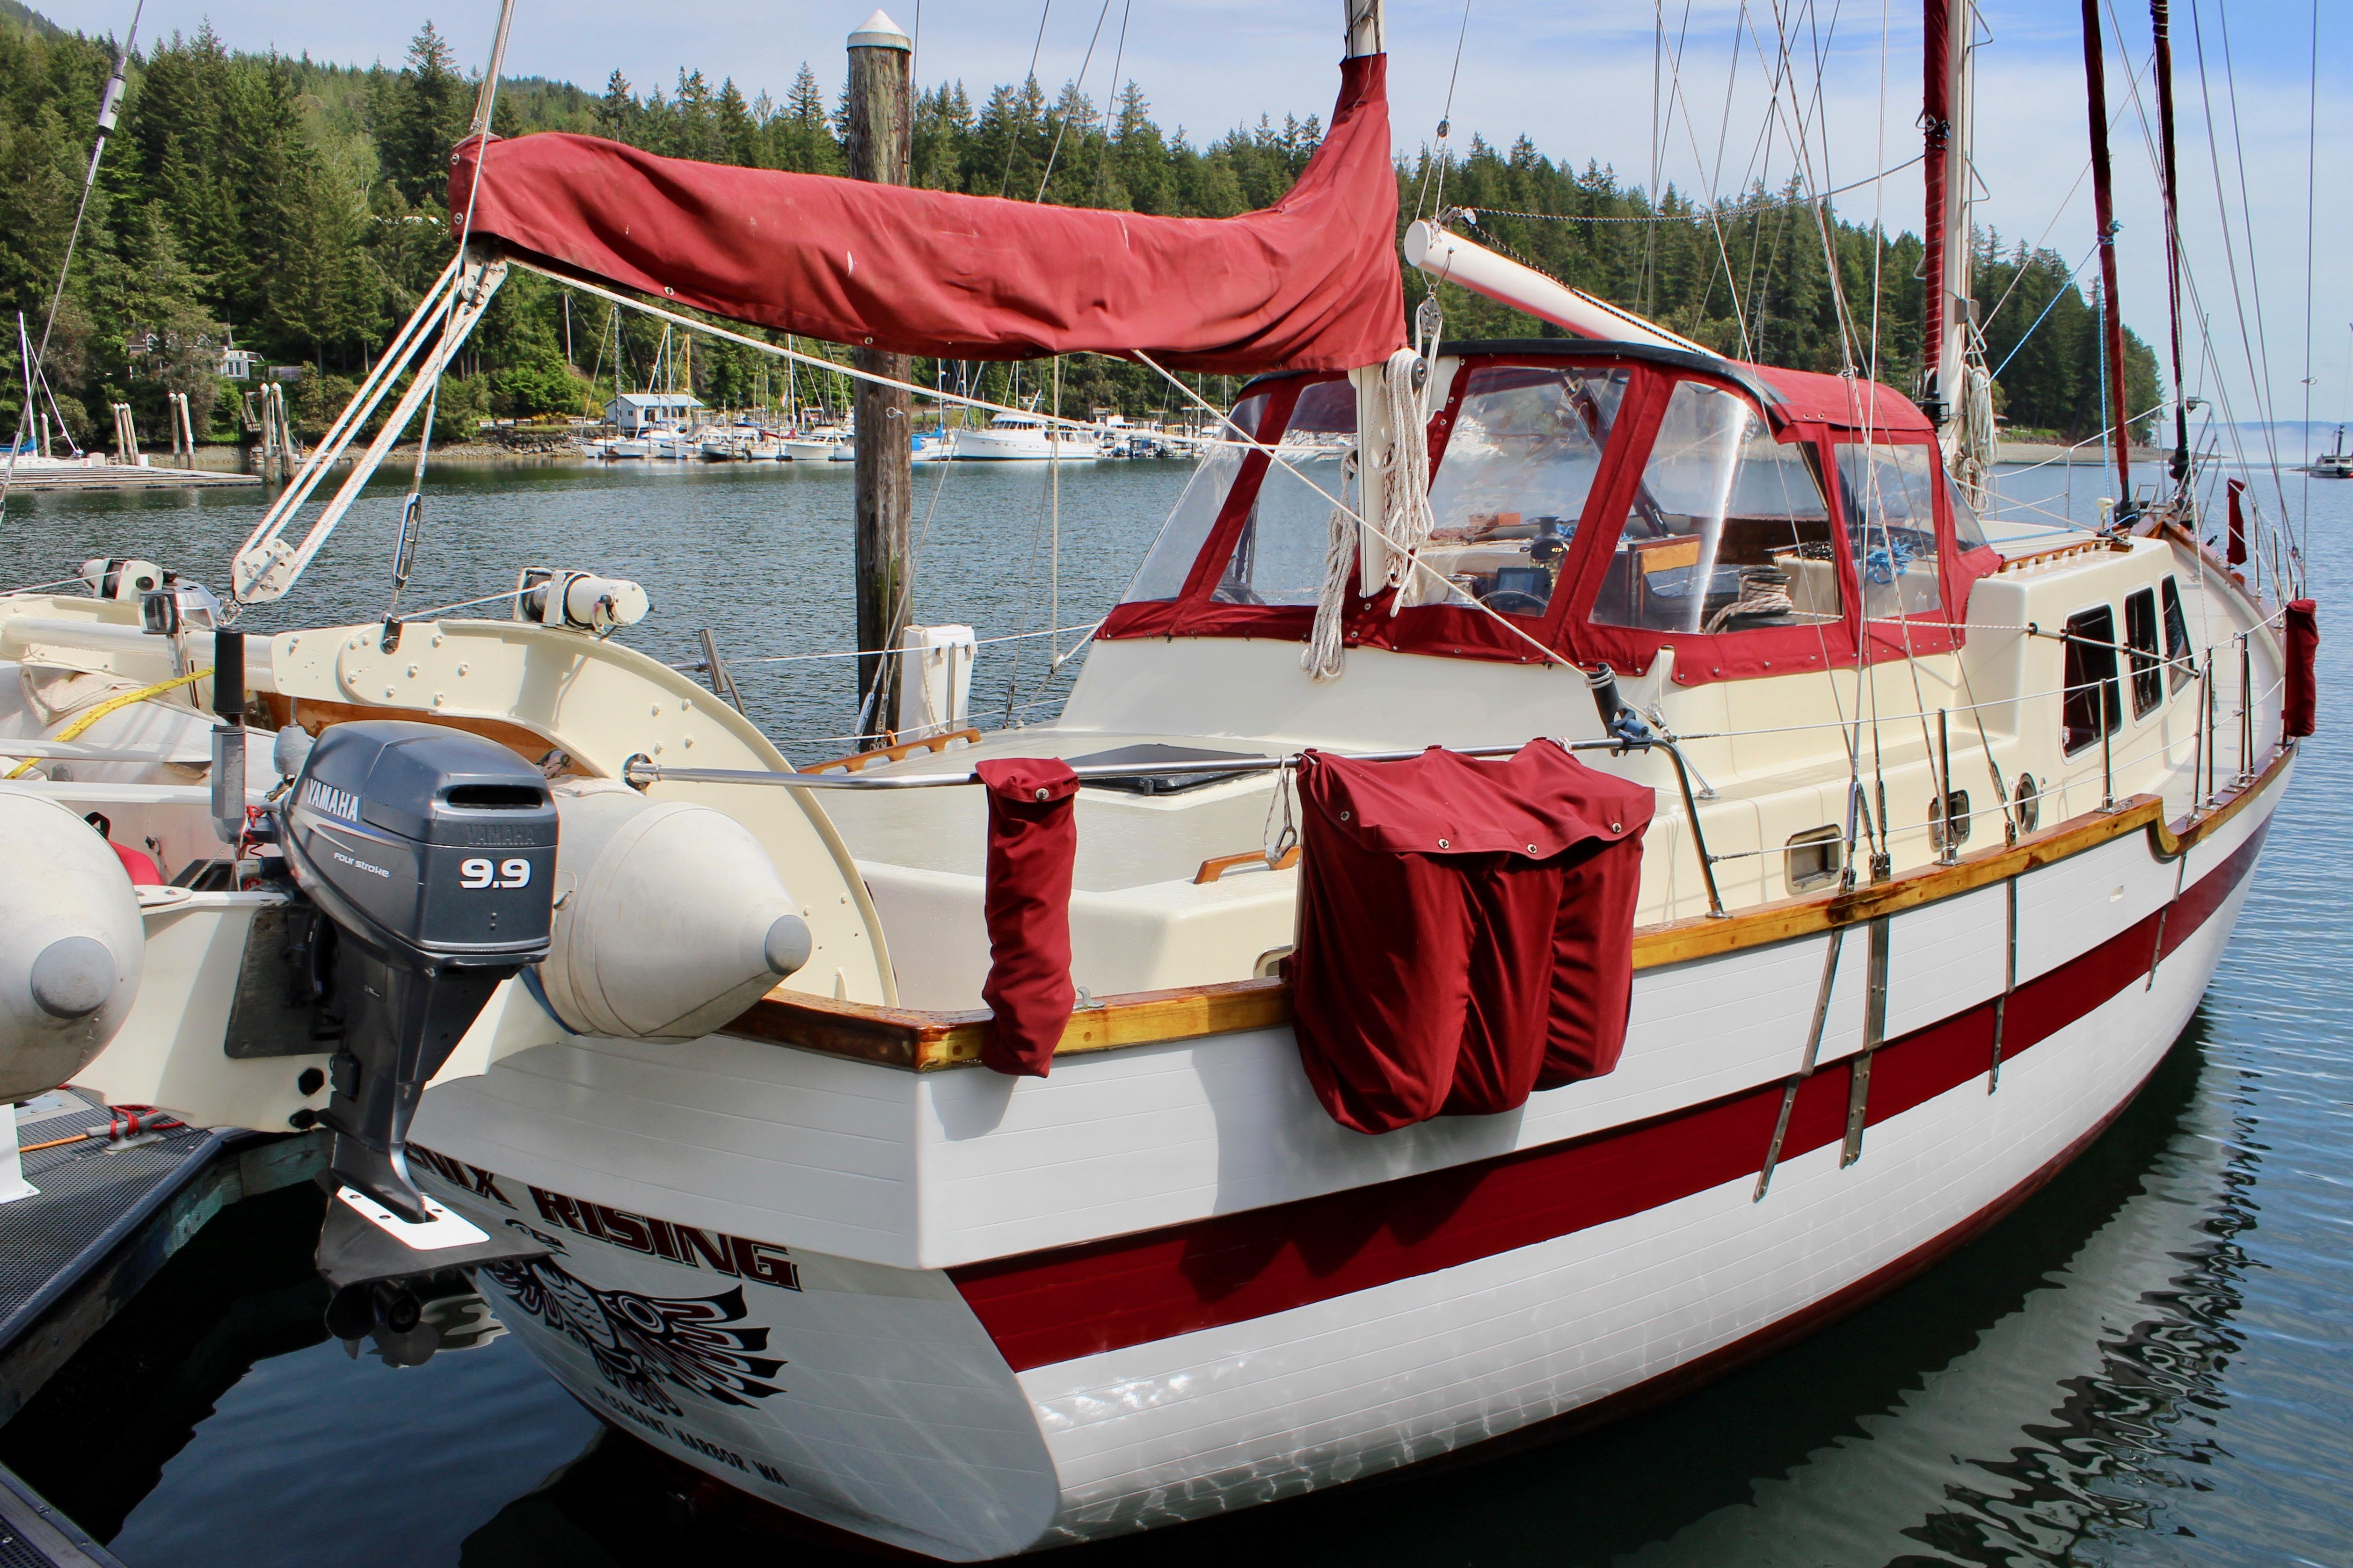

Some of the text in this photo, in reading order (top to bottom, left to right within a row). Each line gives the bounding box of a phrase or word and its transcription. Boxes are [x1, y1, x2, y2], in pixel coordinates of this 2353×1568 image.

[308, 778, 359, 822] YAMAHA
[467, 824, 535, 845] YAMAHA
[460, 858, 531, 888] 9.9
[526, 1184, 803, 1292] RISING
[673, 1427, 750, 1473] HARBOR
[751, 1459, 790, 1488] WA
